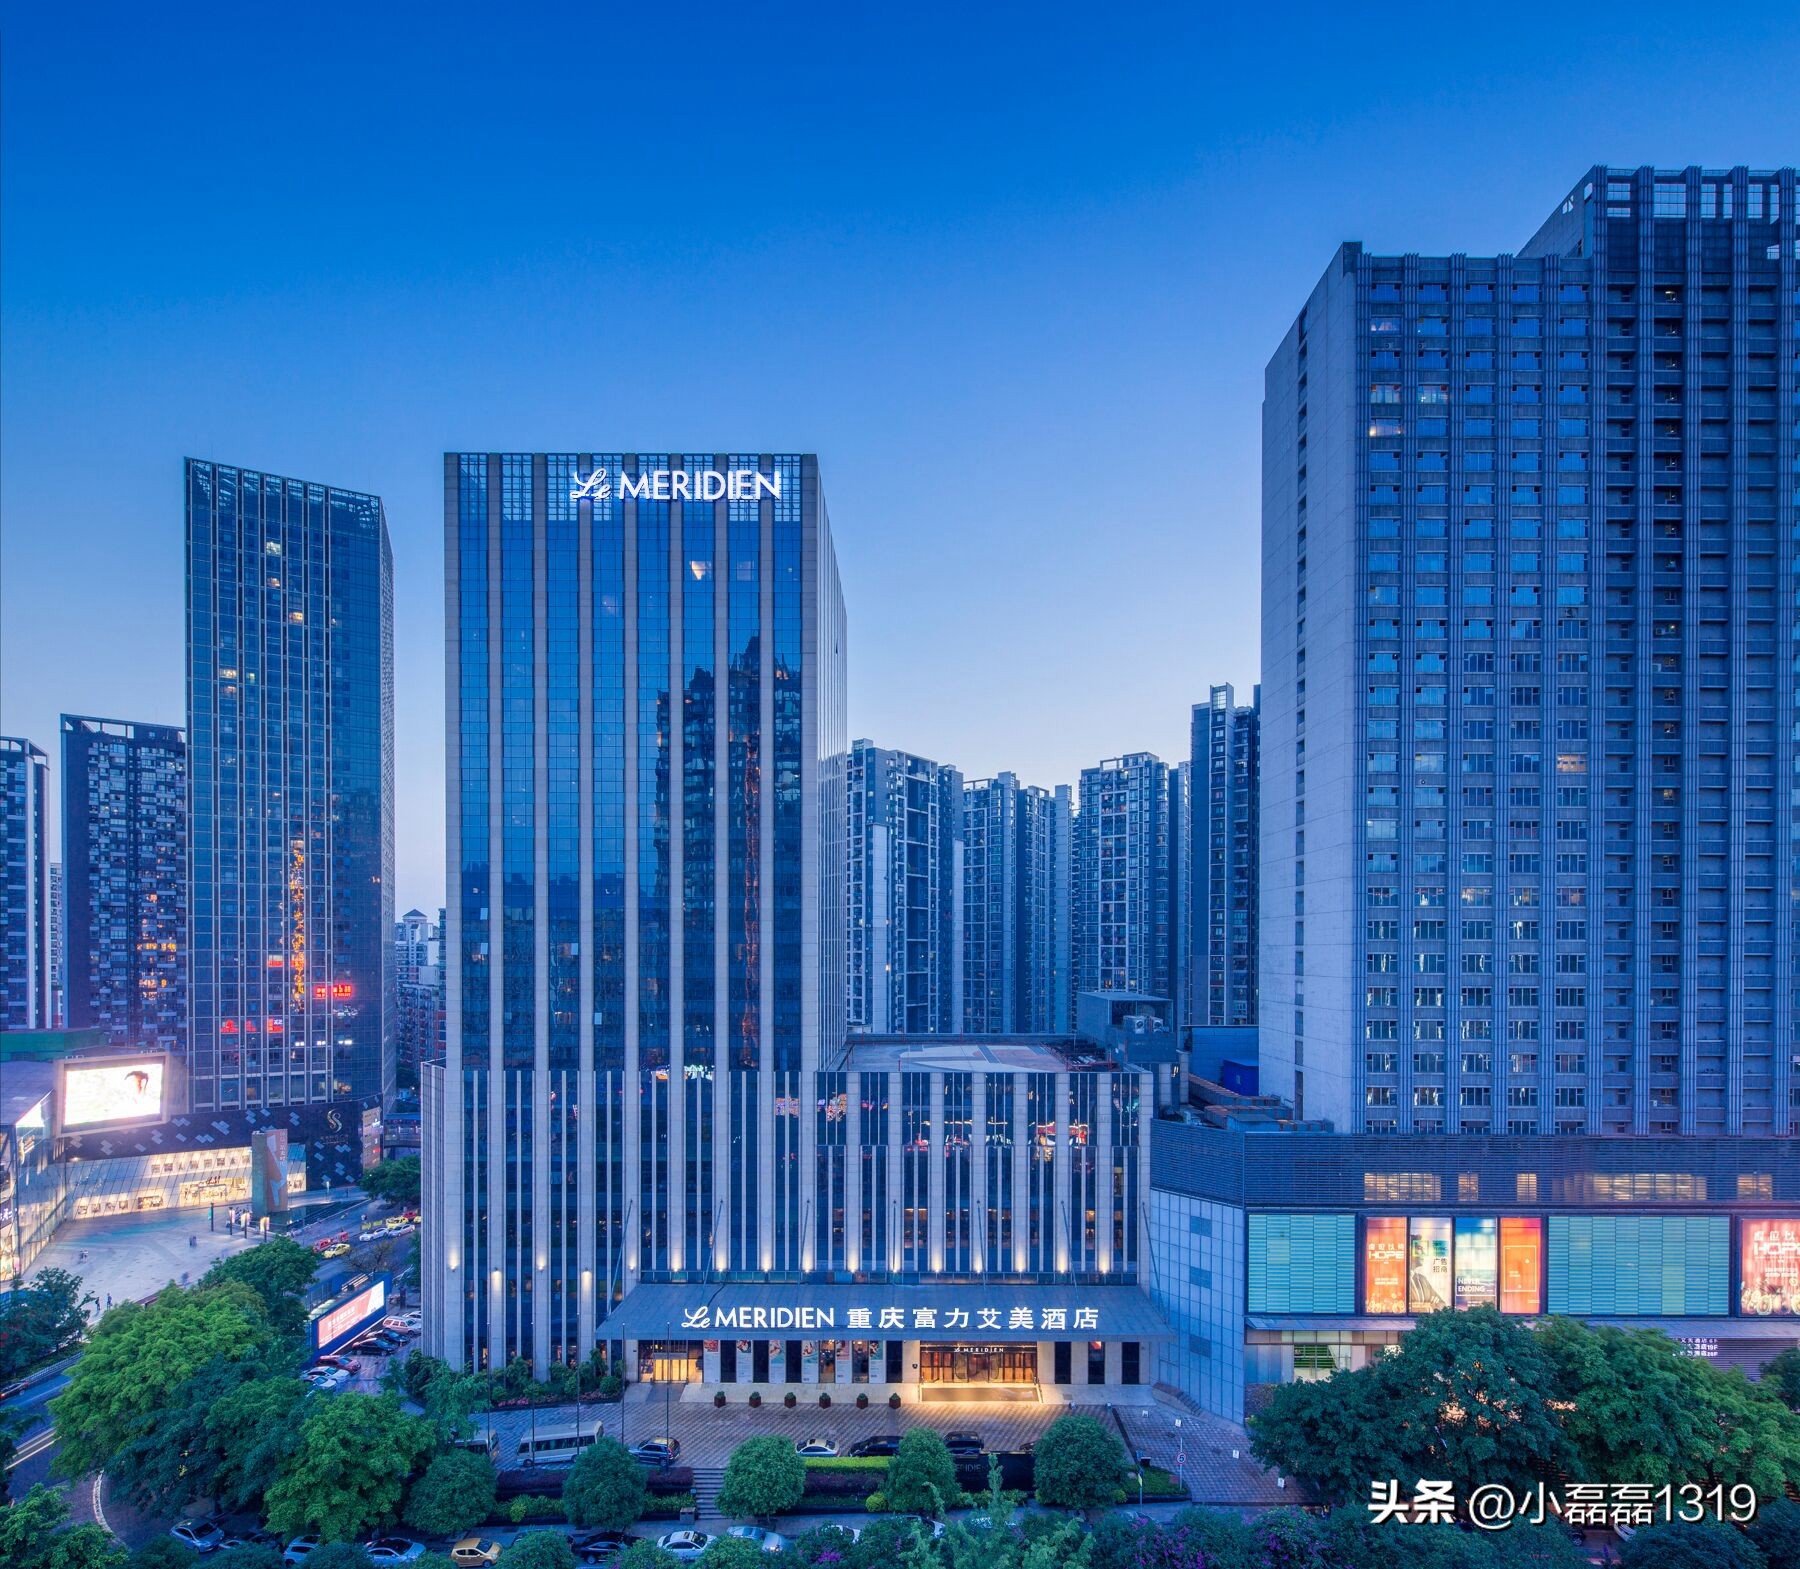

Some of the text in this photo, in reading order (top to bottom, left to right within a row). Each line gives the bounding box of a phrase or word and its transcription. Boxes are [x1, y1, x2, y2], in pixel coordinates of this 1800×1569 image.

[569, 467, 781, 501] Le MERIDIEN
[1753, 1242, 1800, 1256] HOP
[1432, 1257, 1448, 1266] 广告
[1457, 1285, 1486, 1293] ENDING
[681, 1305, 1099, 1330] Le MERIDIEN 重庆富力艾美酒店
